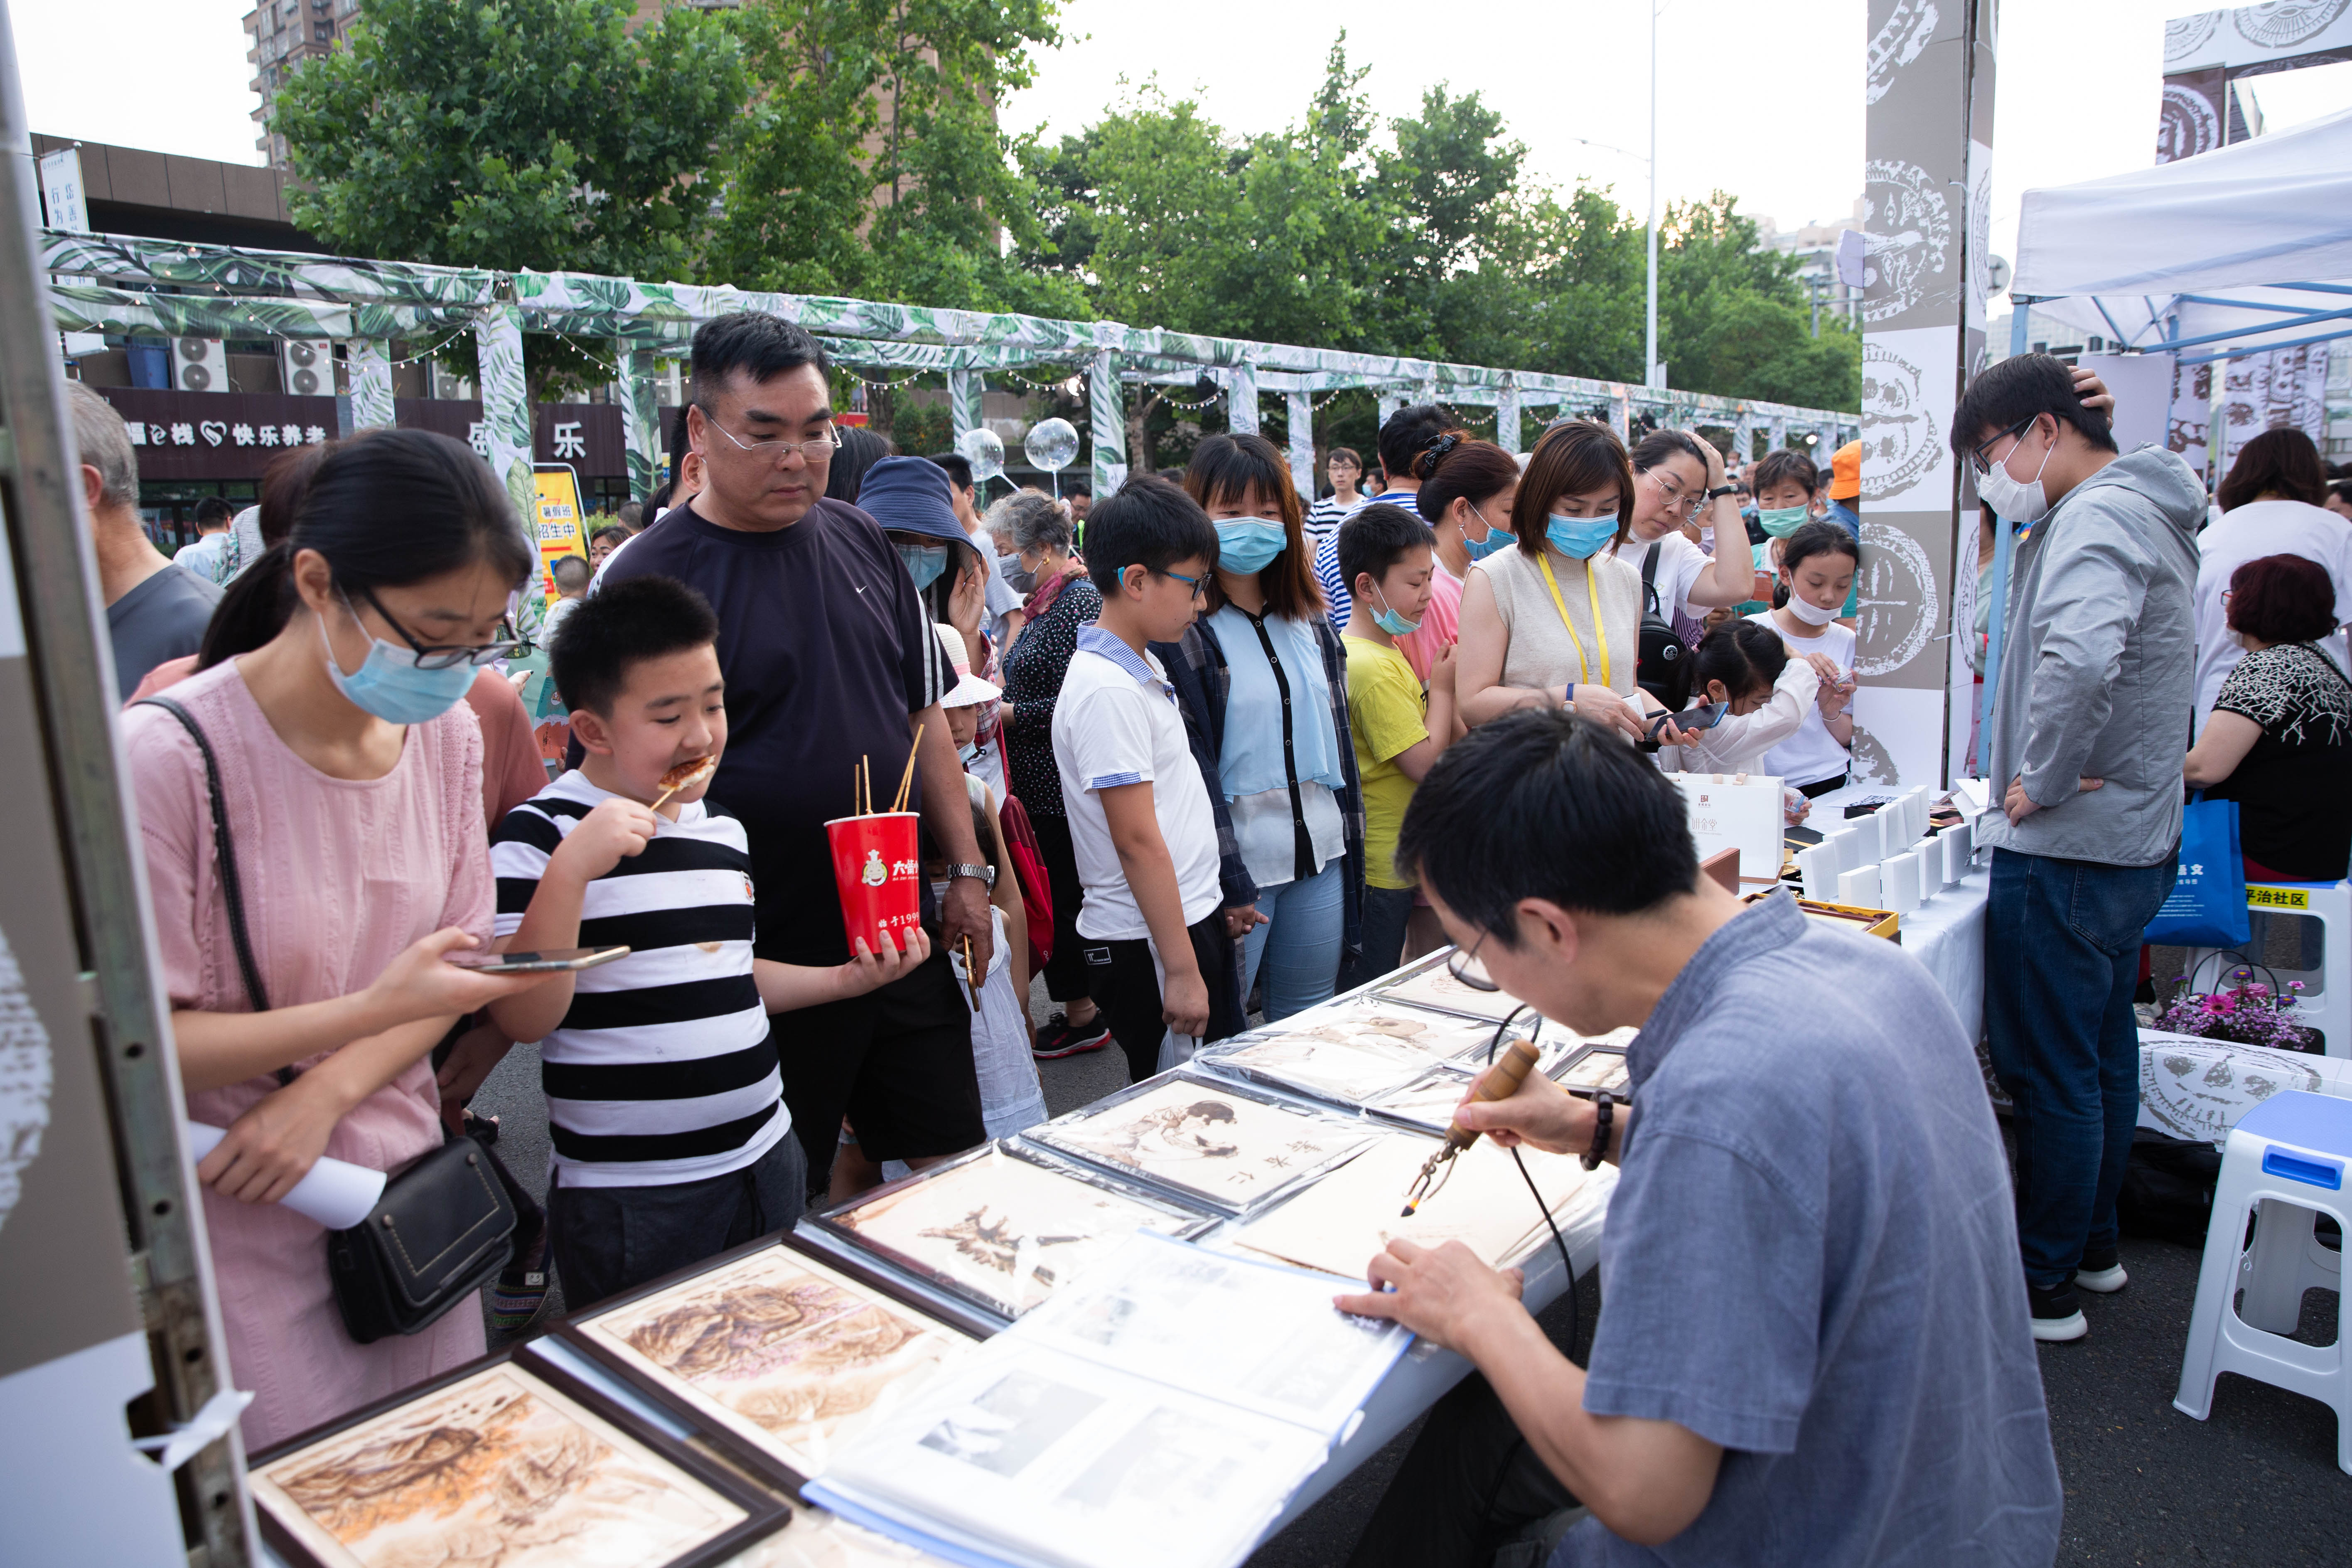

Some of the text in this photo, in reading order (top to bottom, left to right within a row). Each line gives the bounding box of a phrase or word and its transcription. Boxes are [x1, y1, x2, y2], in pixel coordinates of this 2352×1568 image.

[232, 423, 326, 447] 快乐养老
[543, 506, 572, 517] 暑假班
[539, 522, 575, 539] 招生中
